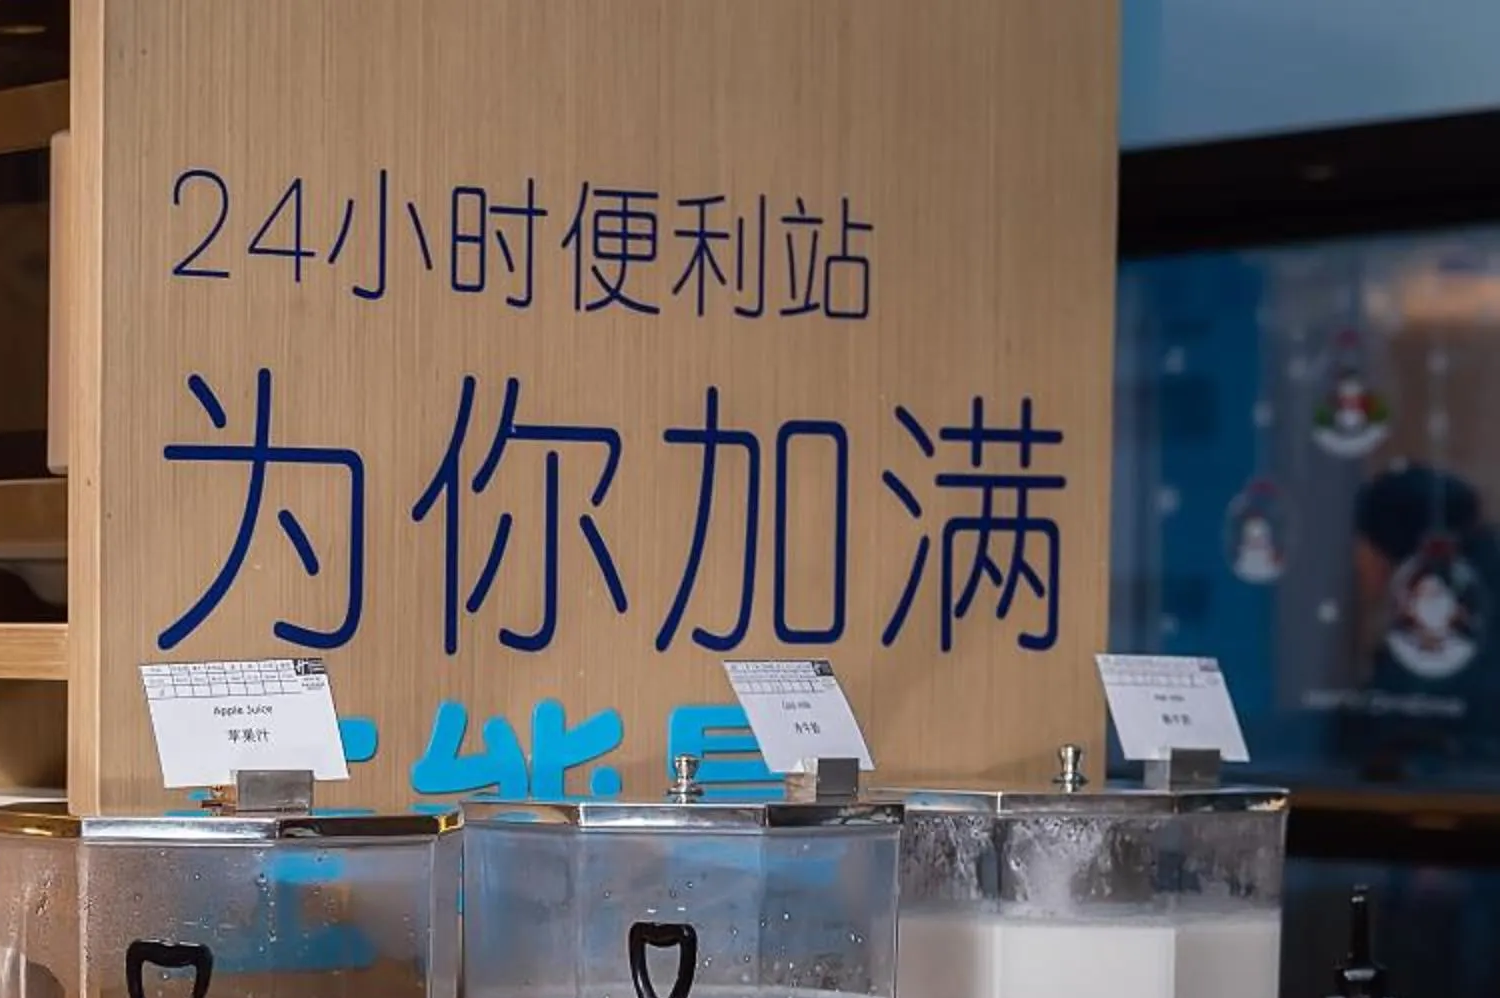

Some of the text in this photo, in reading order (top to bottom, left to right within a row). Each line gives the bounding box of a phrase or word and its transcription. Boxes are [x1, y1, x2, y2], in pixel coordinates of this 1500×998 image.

[172, 168, 874, 319] 24小时便利站
[157, 367, 1067, 655] 为你加满
[213, 704, 273, 717] Apple Juice
[227, 728, 271, 744] 苹果汁
